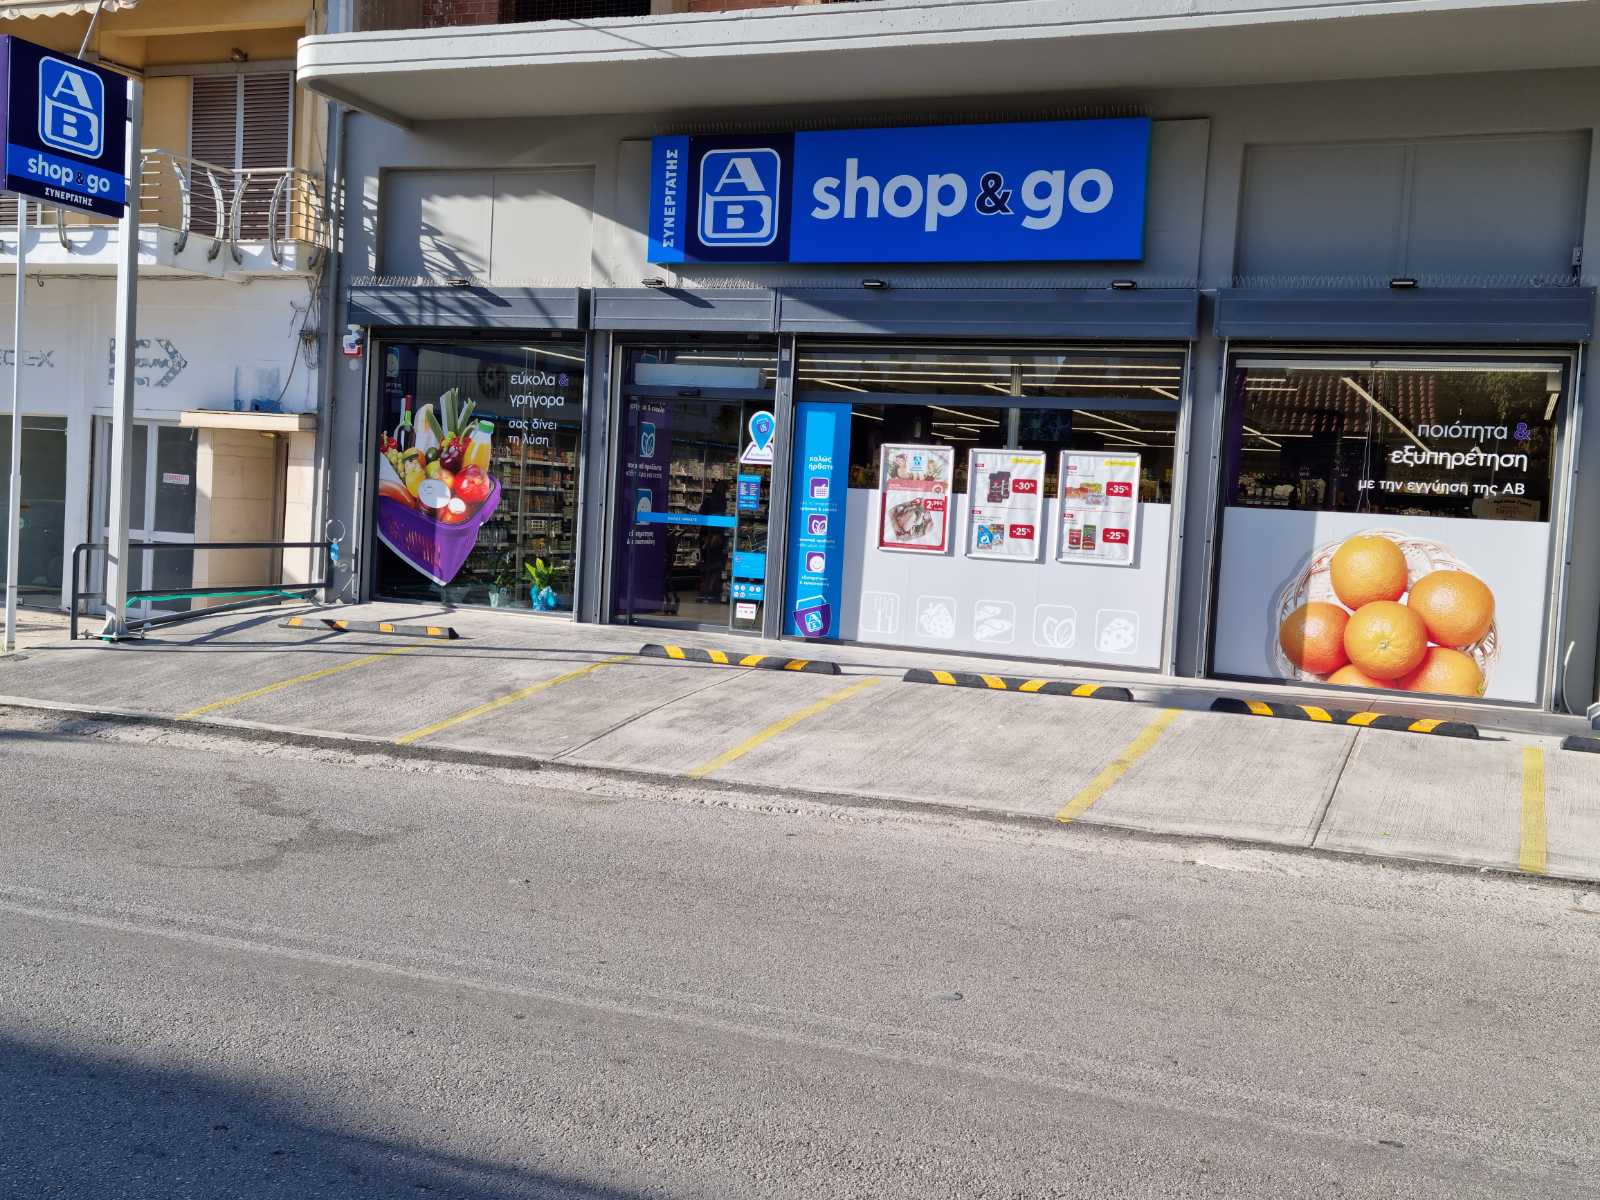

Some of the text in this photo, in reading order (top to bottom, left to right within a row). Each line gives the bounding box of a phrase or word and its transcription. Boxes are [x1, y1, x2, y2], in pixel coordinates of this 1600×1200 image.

[28, 154, 73, 186] shop
[87, 173, 110, 194] go
[44, 187, 93, 206] ΣΥΝΕΡΓΑΤΗΣ
[662, 149, 678, 248] ΣΥΝΕΡΓΑΤΗΣ
[811, 157, 1114, 232] shop & go
[511, 371, 555, 386] εύκολα
[509, 392, 564, 408] γρήγορα
[508, 418, 557, 430] σας δίνει
[1417, 420, 1532, 443] ποιότητα &
[507, 432, 549, 447] τη λύση
[1357, 479, 1375, 491] με
[1379, 480, 1403, 492] την
[1407, 479, 1469, 495] εγγύηση
[1472, 483, 1498, 496] της
